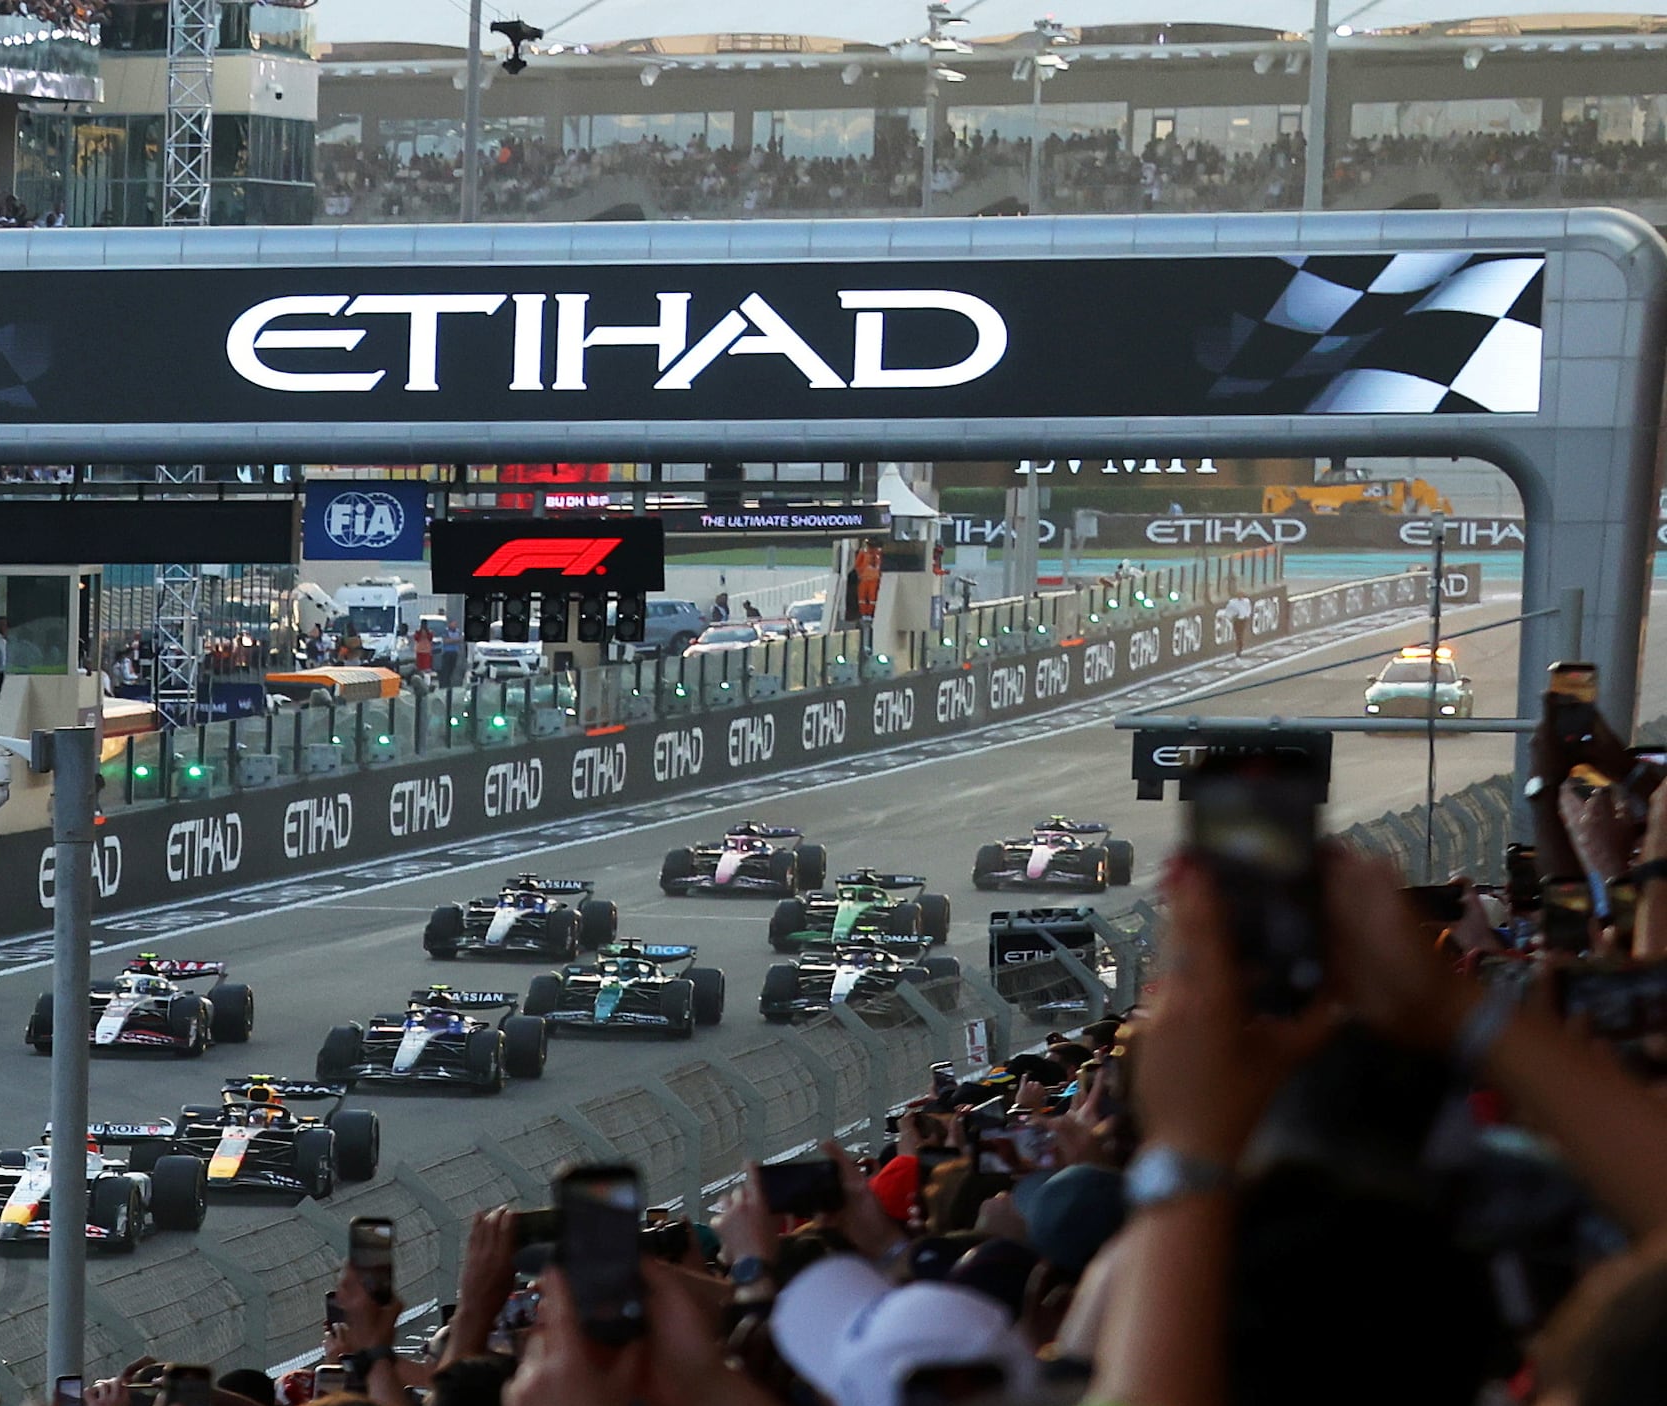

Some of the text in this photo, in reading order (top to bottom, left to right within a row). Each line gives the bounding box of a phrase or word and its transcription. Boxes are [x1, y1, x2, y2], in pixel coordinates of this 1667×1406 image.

[227, 289, 1009, 393] ETIHAD
[543, 494, 566, 509] BU
[700, 514, 863, 528] THE ULTIMATE SHOWDOWN
[943, 519, 1056, 543] TIHAD
[1146, 518, 1307, 544] ETIHAD
[1399, 520, 1524, 545] ETIHA
[1035, 654, 1070, 698] ETIHAD
[1083, 640, 1116, 684] ETIHAD
[937, 675, 976, 722] ETIHAD
[989, 665, 1027, 710] ETIHAD
[803, 699, 847, 750] ETIHAD
[873, 687, 915, 735] ETIHAD
[654, 727, 704, 782] ETIHAD
[728, 714, 775, 767] ETIHAD
[484, 758, 543, 817] ETIHAD
[572, 743, 627, 799] ETIHAD
[284, 793, 353, 859] ETIHAD
[389, 775, 453, 837] ETIHAD
[167, 812, 243, 882] ETIHAD
[39, 834, 122, 908] EAD
[538, 881, 582, 889] ASSIAN
[644, 945, 685, 956] mco
[451, 993, 504, 1003] ASSIAN
[93, 1124, 142, 1134] UDOR
